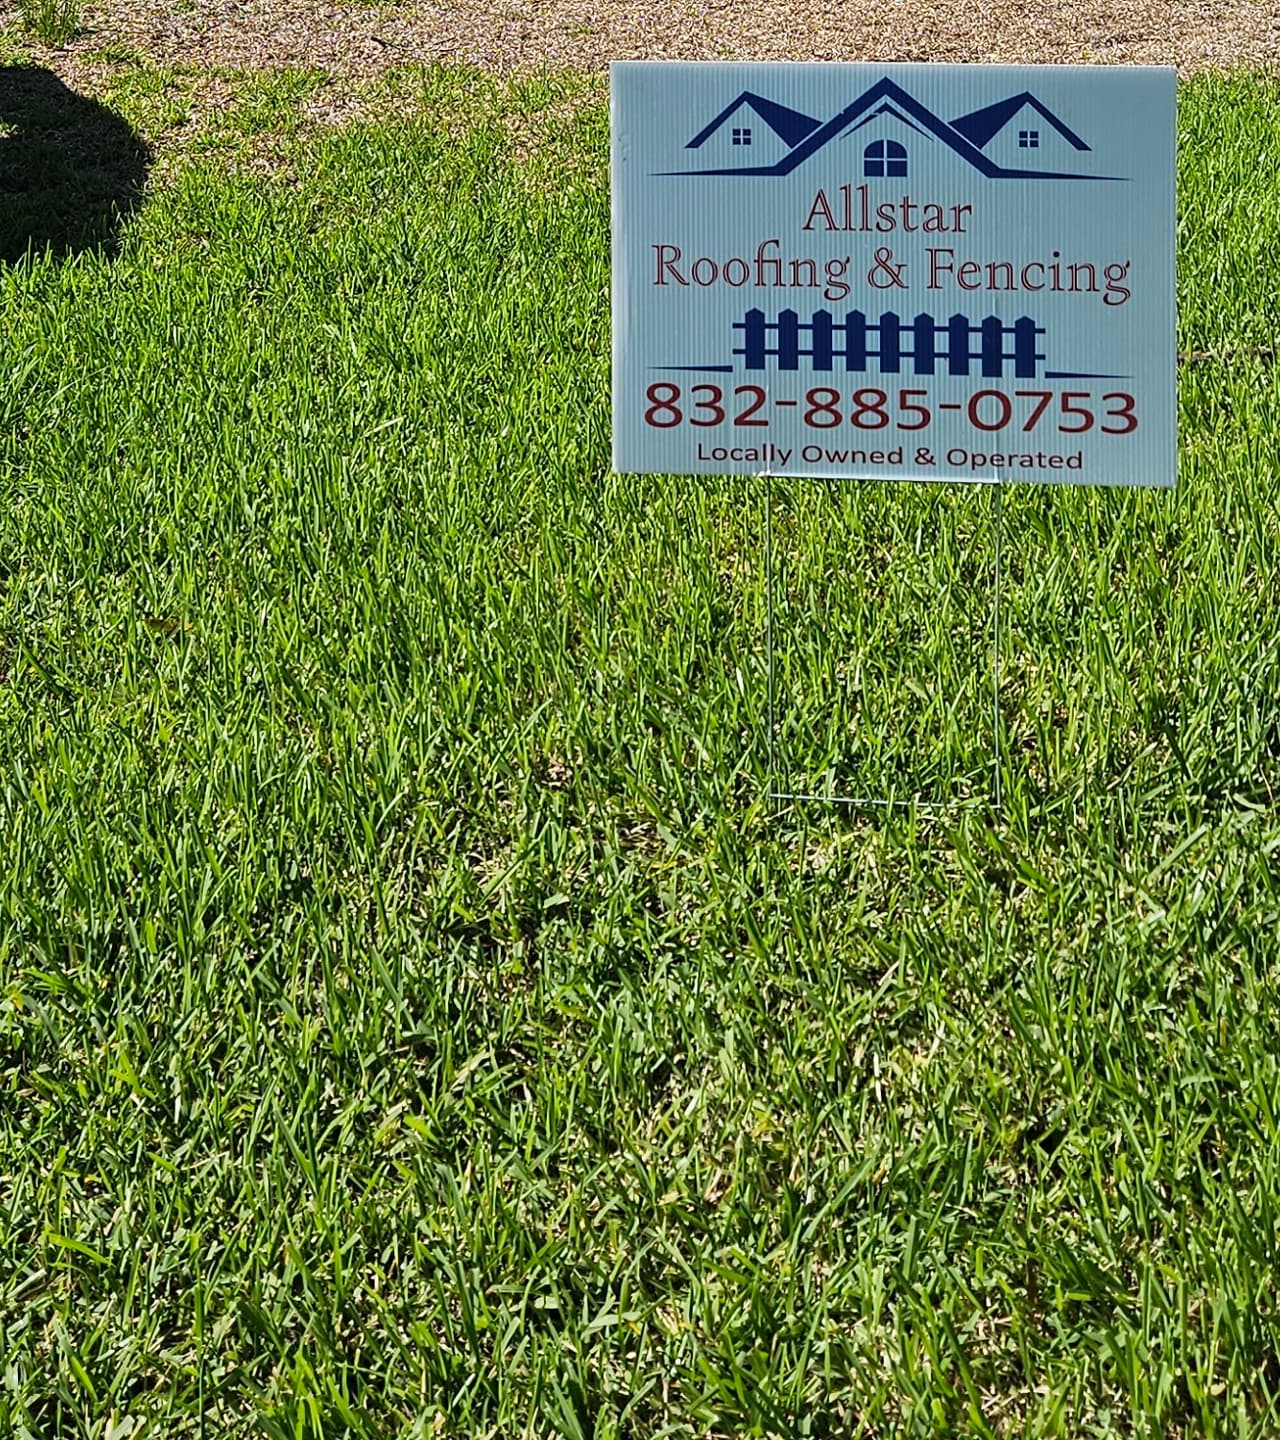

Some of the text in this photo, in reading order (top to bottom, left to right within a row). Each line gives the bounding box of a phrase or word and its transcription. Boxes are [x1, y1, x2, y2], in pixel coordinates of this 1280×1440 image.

[802, 183, 973, 233] Allstar
[652, 239, 1131, 306] Roofing & Fencing
[644, 382, 1139, 435] 832-885-0753
[697, 442, 1083, 471] Locally Owned & Operated
